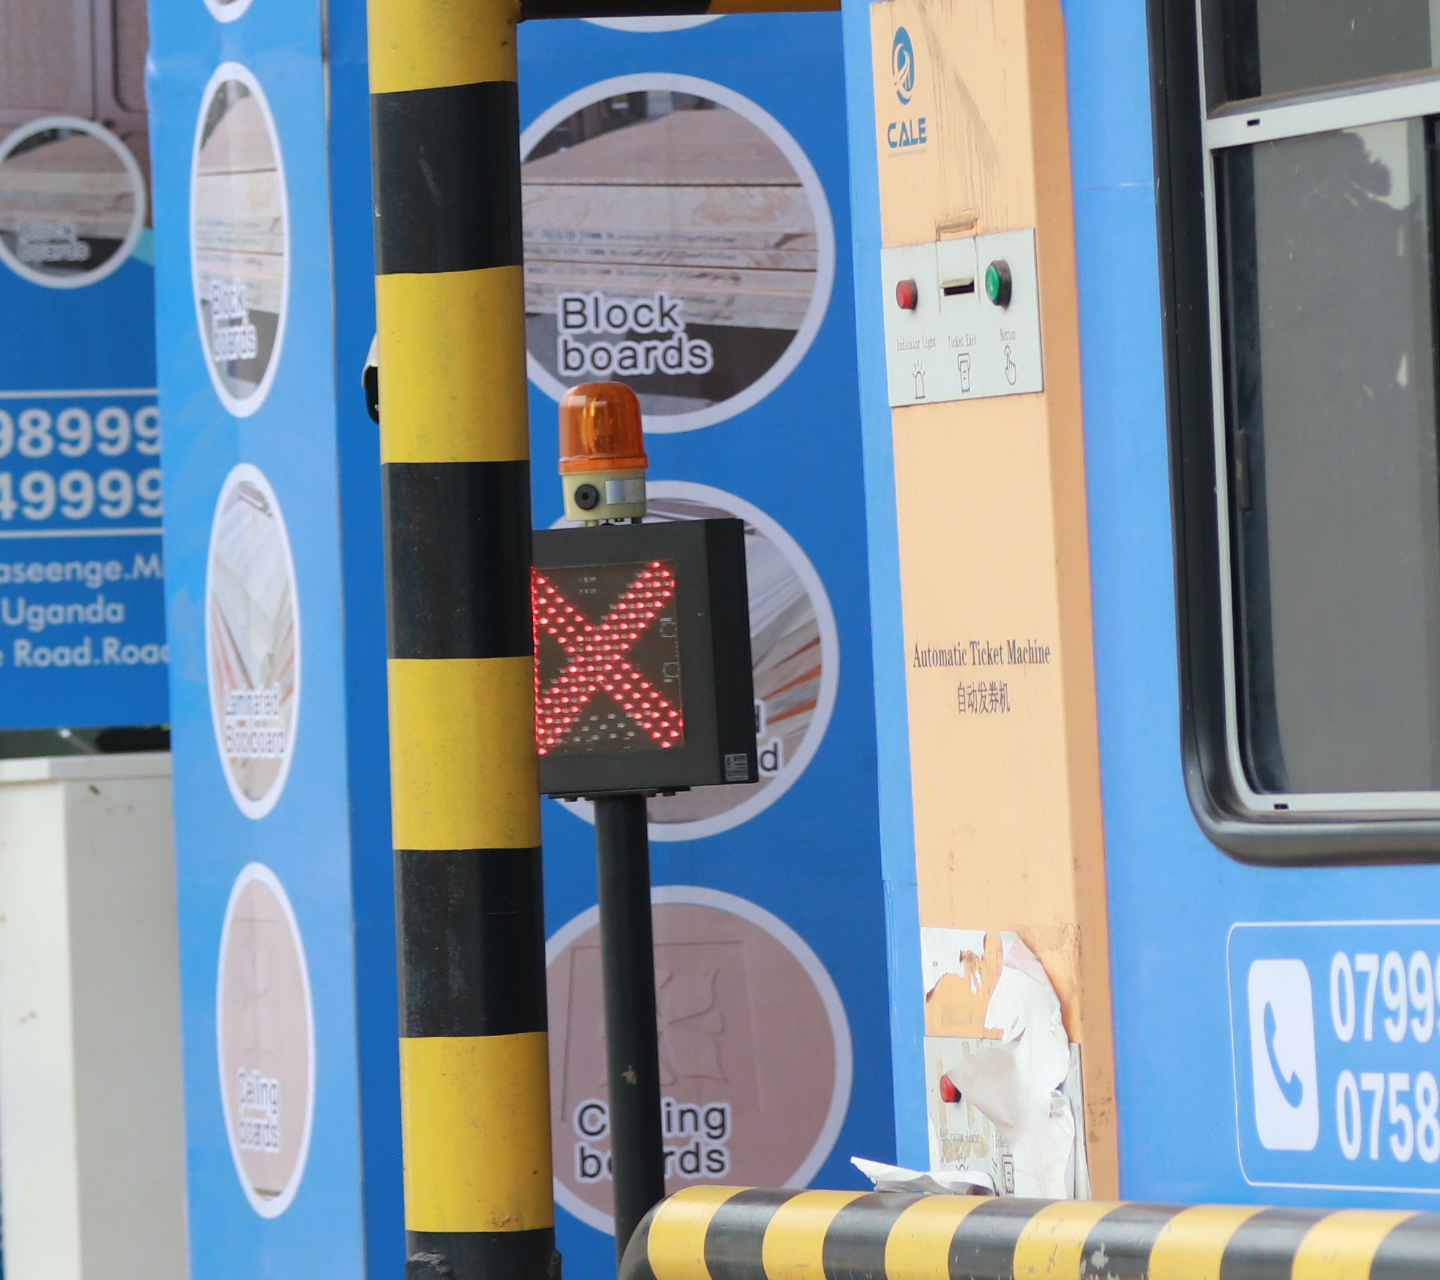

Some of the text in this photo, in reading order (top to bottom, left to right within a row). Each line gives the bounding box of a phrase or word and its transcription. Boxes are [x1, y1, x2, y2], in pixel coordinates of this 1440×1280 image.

[887, 117, 927, 148] CALE
[562, 293, 682, 331] Block
[562, 335, 711, 373] boards
[913, 638, 1051, 668] Automatic Ticket Machine
[579, 1141, 728, 1178] brds
